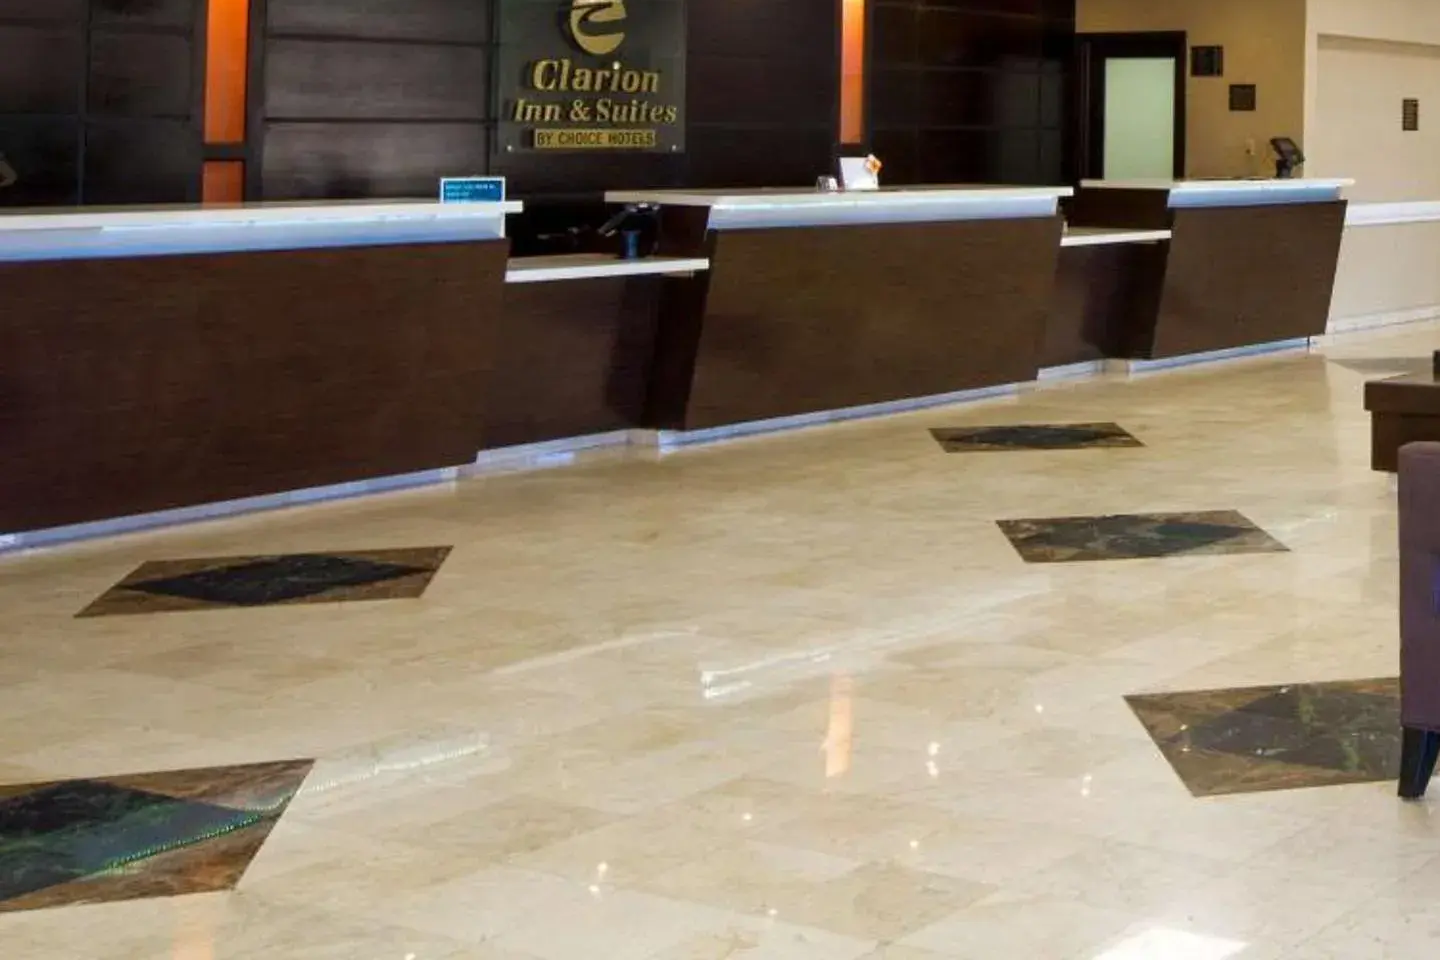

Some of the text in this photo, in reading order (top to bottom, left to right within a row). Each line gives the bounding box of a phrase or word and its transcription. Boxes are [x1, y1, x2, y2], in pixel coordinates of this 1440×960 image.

[532, 58, 660, 92] Clarion
[514, 98, 677, 123] Inn & Suites
[537, 132, 654, 146] BY CHOICE HOTELS
